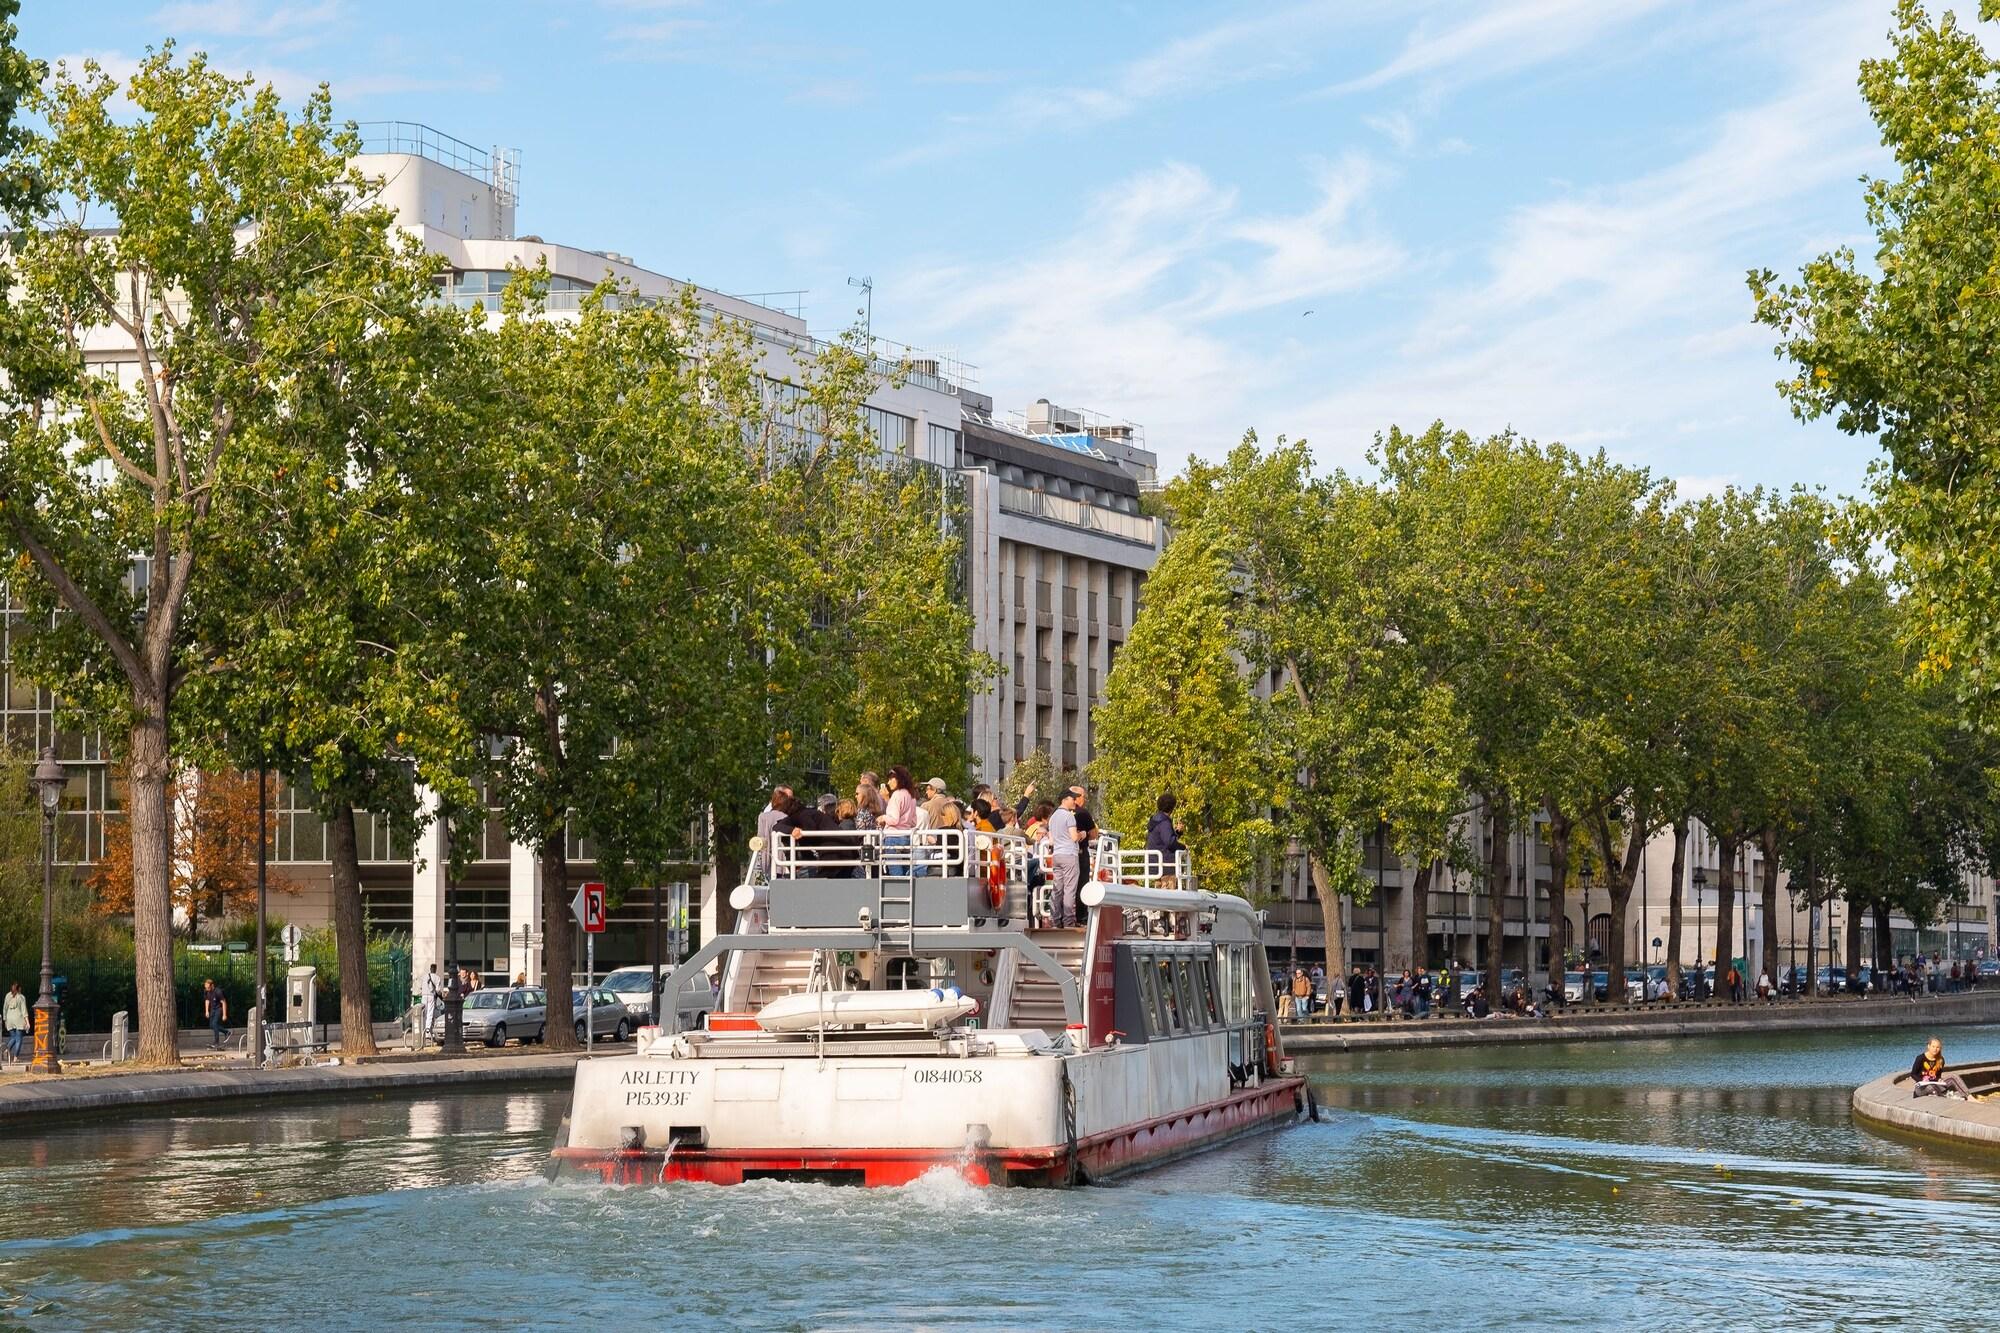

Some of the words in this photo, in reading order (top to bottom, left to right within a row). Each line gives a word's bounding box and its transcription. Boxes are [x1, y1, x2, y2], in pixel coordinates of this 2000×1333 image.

[620, 1070, 700, 1085] ARLETTY
[914, 1069, 983, 1083] 01841058
[626, 1091, 692, 1106] P15393F
